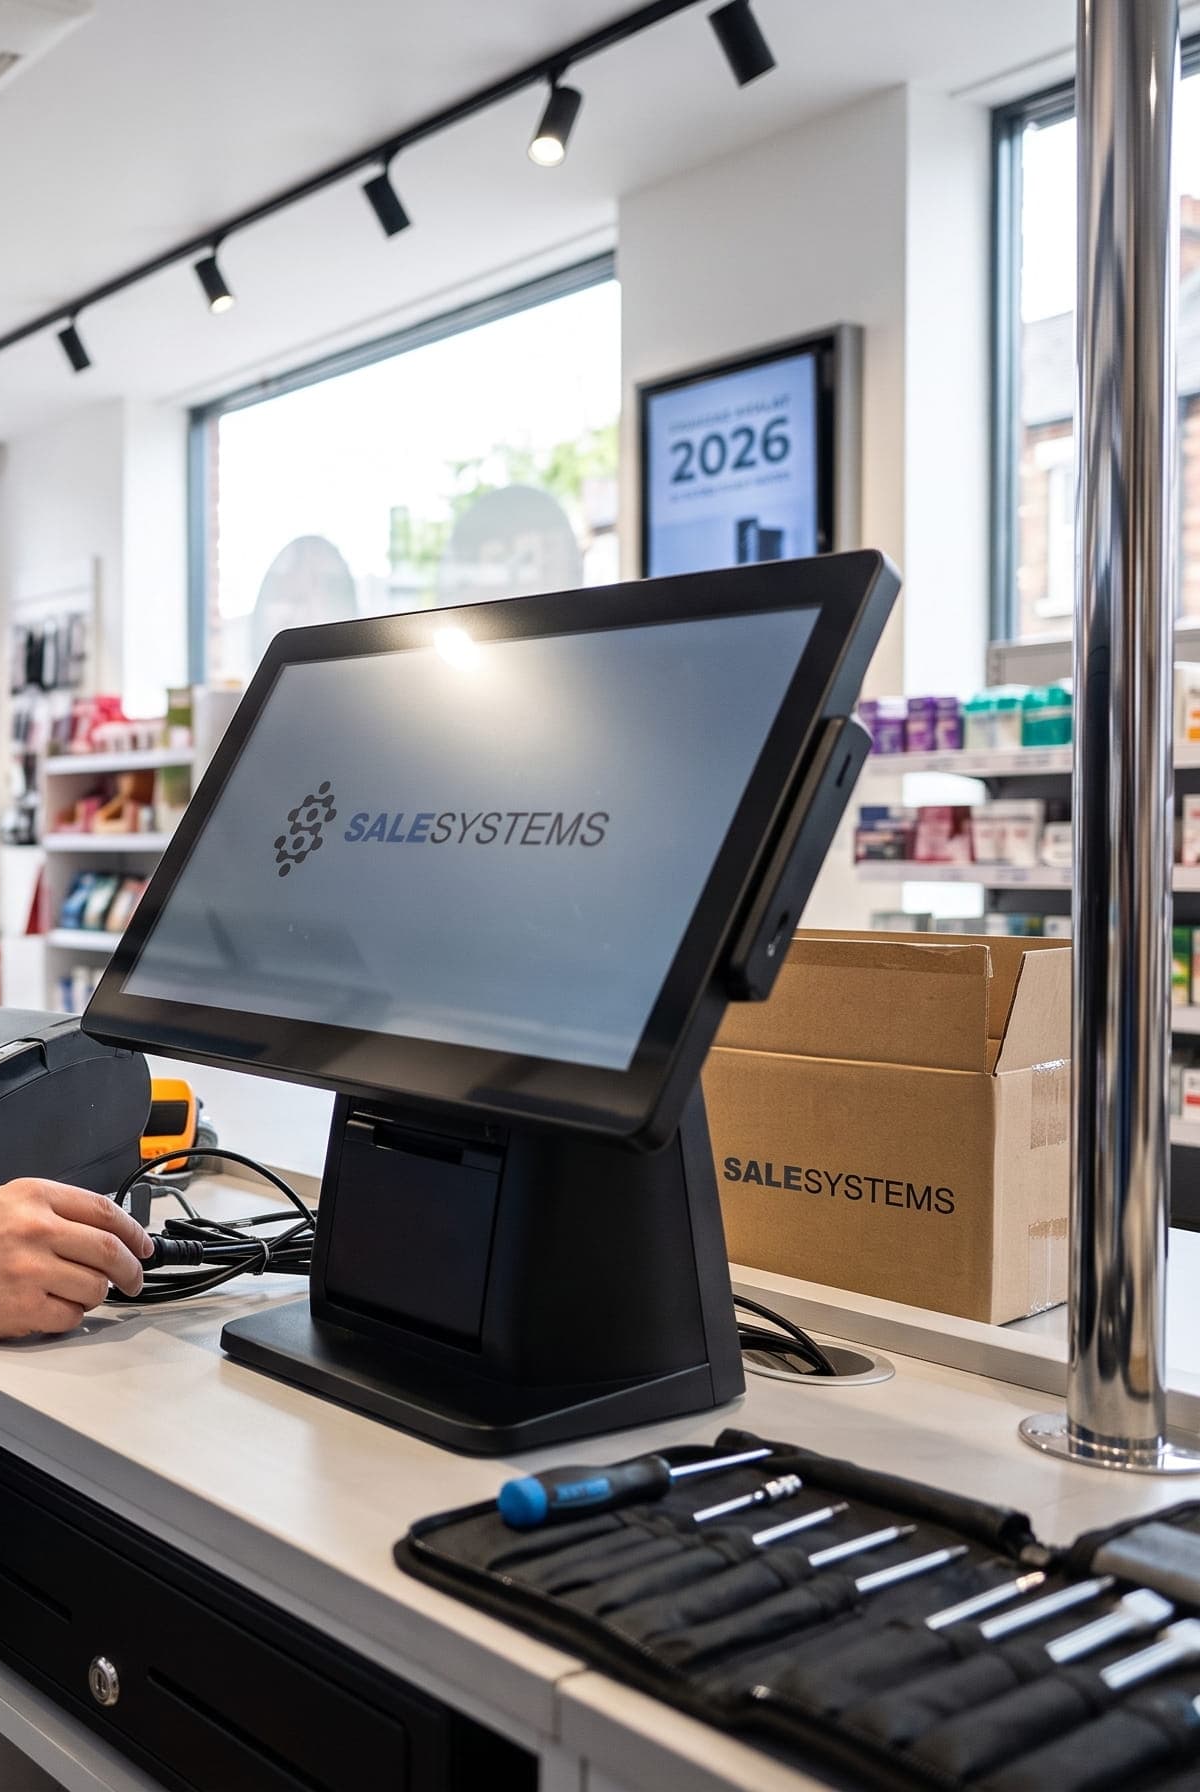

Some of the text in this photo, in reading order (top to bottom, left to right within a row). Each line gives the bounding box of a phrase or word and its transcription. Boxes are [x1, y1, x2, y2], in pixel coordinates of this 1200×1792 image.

[669, 415, 791, 485] 2026
[344, 811, 610, 847] SALESYSTEMS
[723, 1156, 956, 1215] SALESYSTEMS
